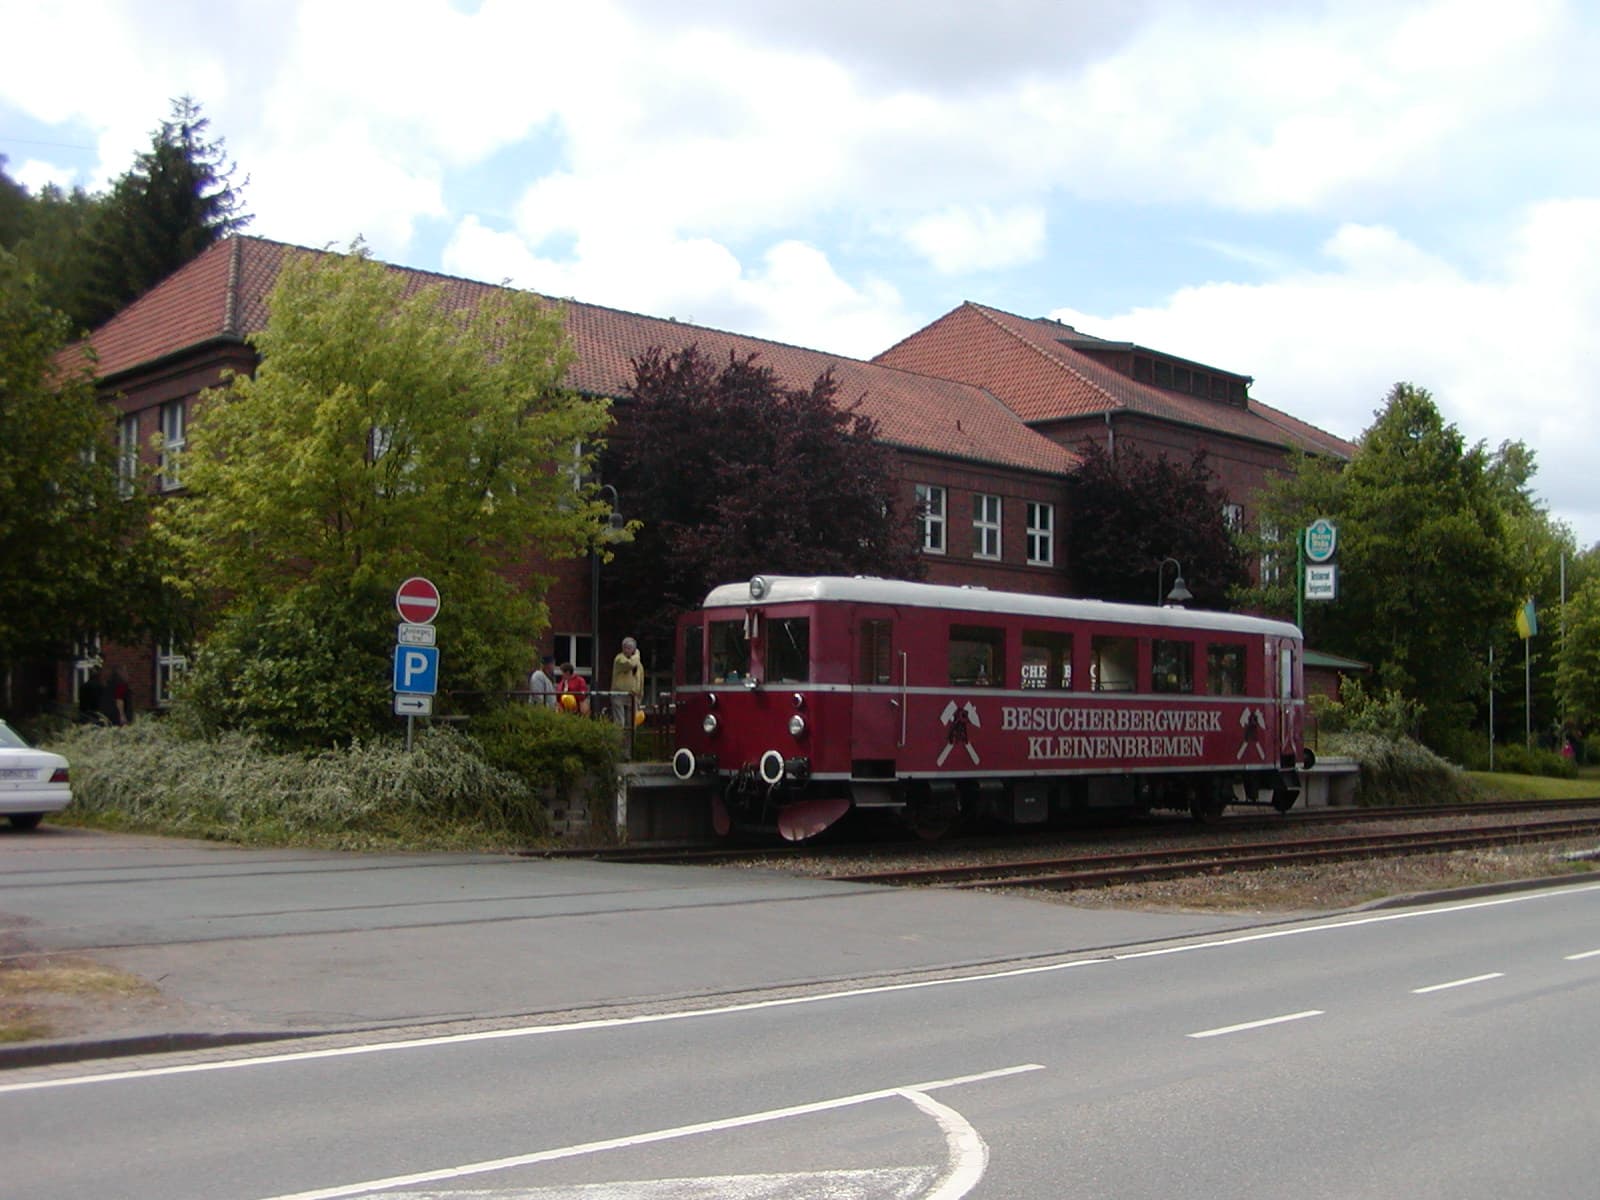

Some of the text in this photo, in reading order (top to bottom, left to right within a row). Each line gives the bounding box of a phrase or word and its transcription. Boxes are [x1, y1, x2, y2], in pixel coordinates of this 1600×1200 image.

[404, 651, 429, 687] P
[1001, 706, 1222, 732] BESUCHERBERGWERK
[1027, 735, 1204, 760] KLEINENBREMEN
